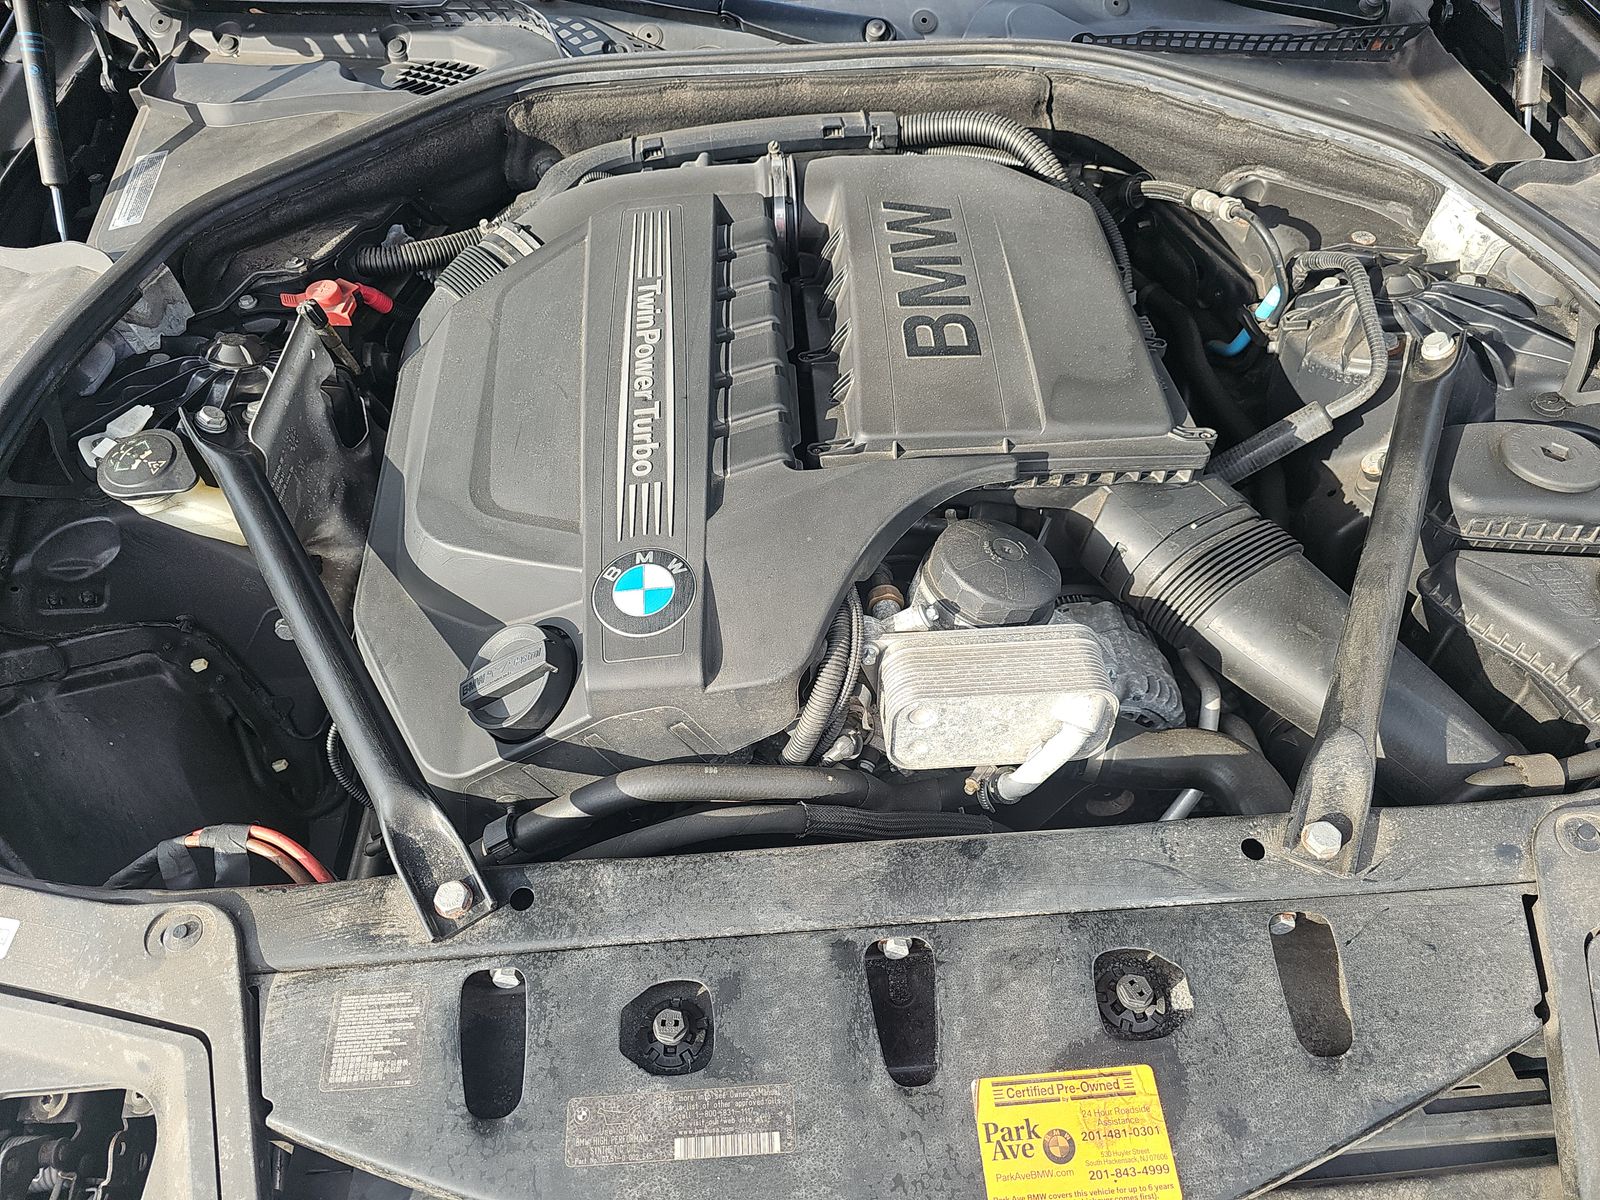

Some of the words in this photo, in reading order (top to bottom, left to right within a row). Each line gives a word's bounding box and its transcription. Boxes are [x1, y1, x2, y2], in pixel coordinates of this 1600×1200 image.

[881, 201, 982, 357] BMW
[632, 279, 662, 399] TwinPower
[631, 401, 661, 477] Turbo
[602, 551, 688, 582] BMW
[1006, 1085, 1054, 1099] Certified
[1056, 1079, 1120, 1095] Pre-Owned
[1081, 1109, 1092, 1118] 24
[1094, 1108, 1113, 1117] Hour
[1114, 1105, 1151, 1115] Roadside
[1097, 1117, 1139, 1126] Assistance
[982, 1118, 1042, 1144] Park
[1081, 1126, 1160, 1141] 201-481-0301
[992, 1140, 1035, 1161] Ave
[1085, 1159, 1103, 1167] South
[1088, 1164, 1170, 1180] 201-843-4999
[995, 1169, 1074, 1183] ParkAveBMW.com
[1048, 1192, 1072, 1200] covers
[1089, 1187, 1115, 1196] vehicle
[1154, 1183, 1174, 1192] years
